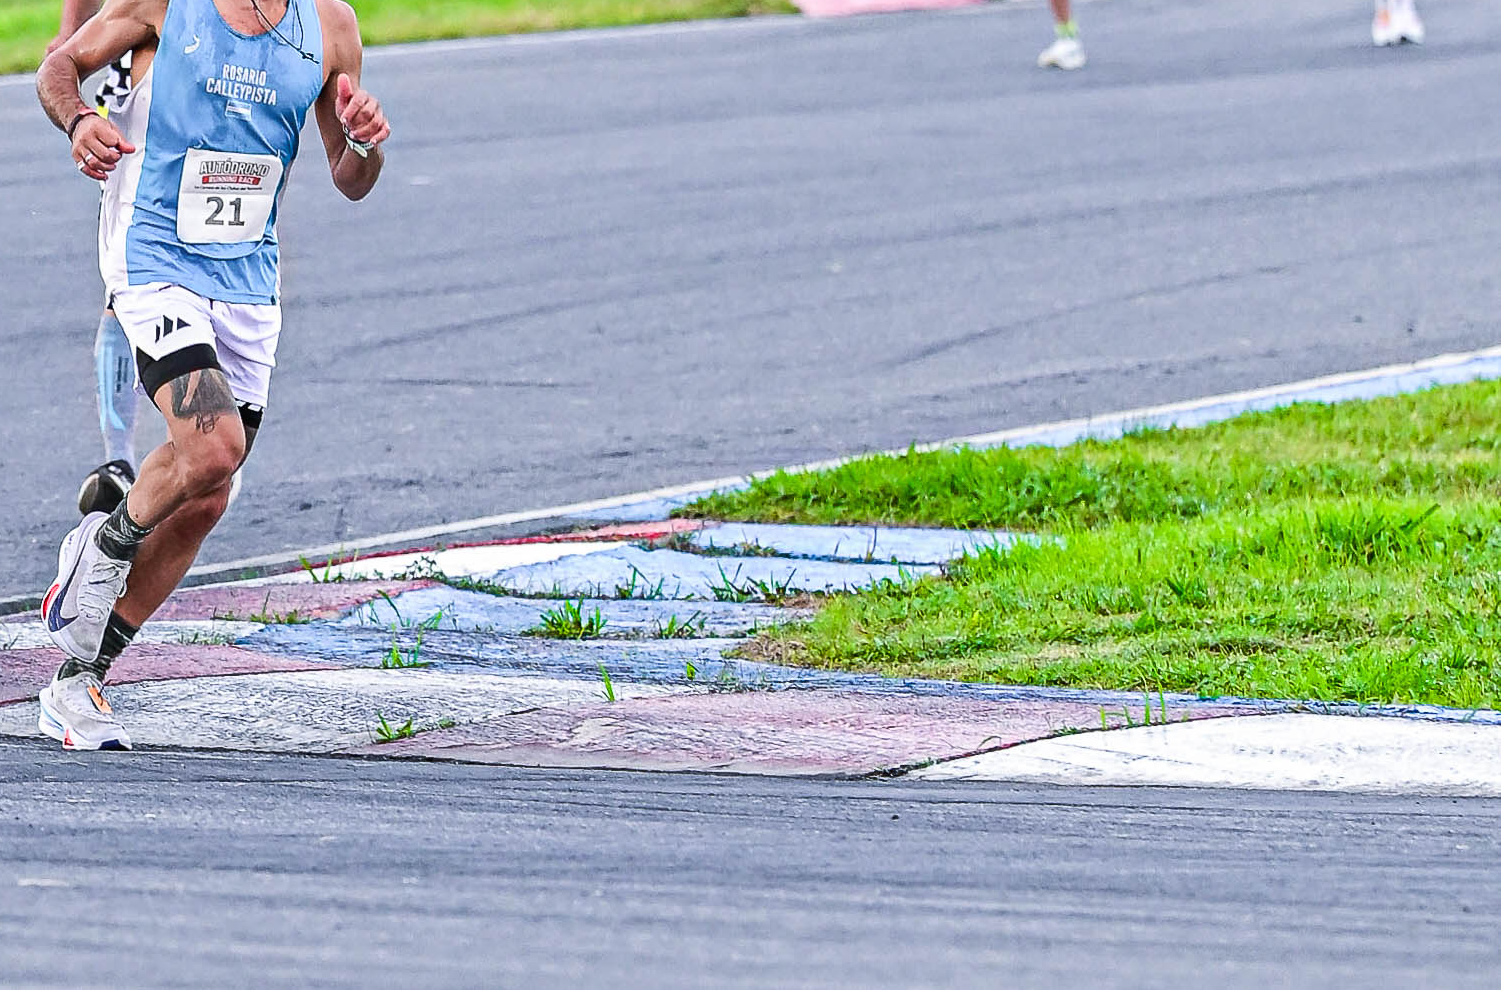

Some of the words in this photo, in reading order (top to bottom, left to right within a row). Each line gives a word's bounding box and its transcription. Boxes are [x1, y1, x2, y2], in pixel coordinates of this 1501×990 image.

[222, 64, 267, 87] ROSARIO
[205, 77, 277, 106] CALLEYPISTA
[199, 157, 271, 178] AUTÓDROMO
[205, 196, 245, 227] 21
